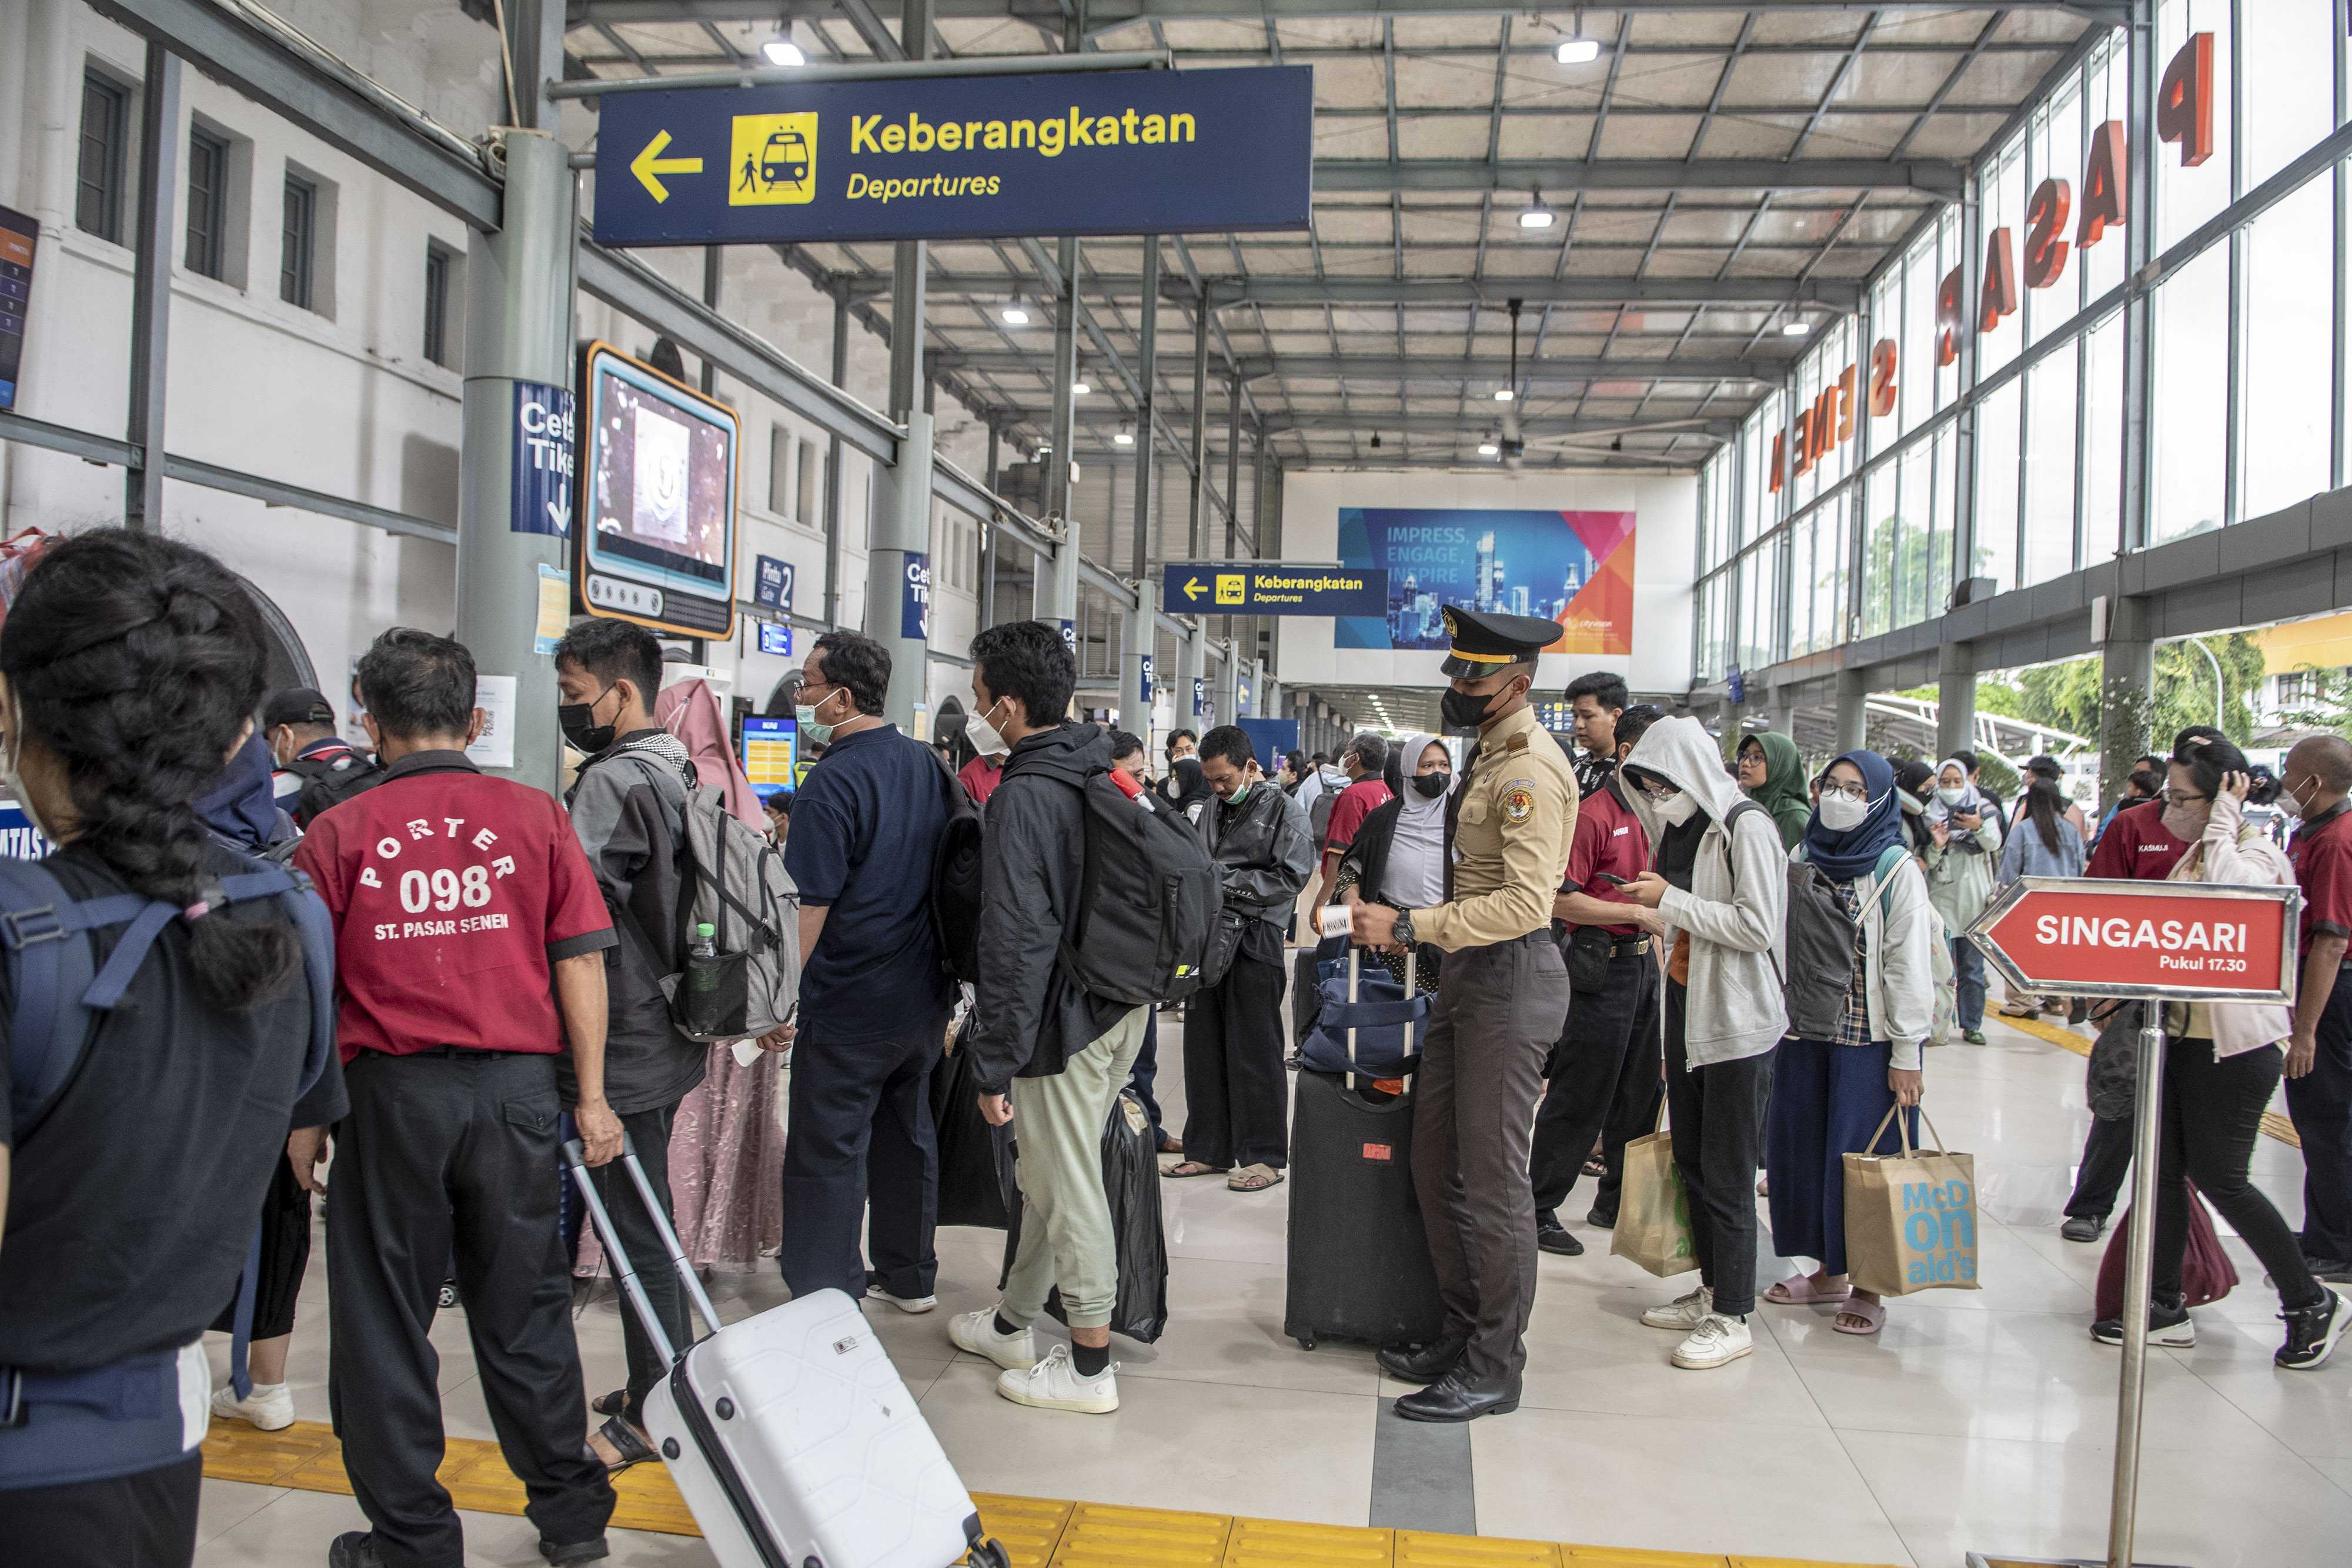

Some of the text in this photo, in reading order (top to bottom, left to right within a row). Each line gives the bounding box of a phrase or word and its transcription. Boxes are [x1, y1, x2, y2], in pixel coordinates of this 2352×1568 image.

[850, 106, 1196, 158] Keberangkatan
[846, 172, 1000, 203] Departures
[1387, 526, 1470, 546] IMPRESS,
[1387, 546, 1465, 565] ENGAGE,
[780, 566, 791, 608] 2
[1254, 574, 1363, 593] Keberangkatan
[1388, 567, 1458, 584] INSPIRE
[1254, 593, 1303, 604] Departures
[359, 817, 516, 888] PORTER
[2138, 844, 2169, 852] KASMUJI
[400, 865, 492, 914] 098
[375, 913, 509, 940] ST. PASAR SENEN
[2035, 914, 2246, 953] SINGASARI
[2159, 955, 2247, 972] Pukul 17.30
[1903, 1179, 1970, 1211] McD
[1904, 1208, 1975, 1252] on
[1908, 1250, 1976, 1284] ald's
